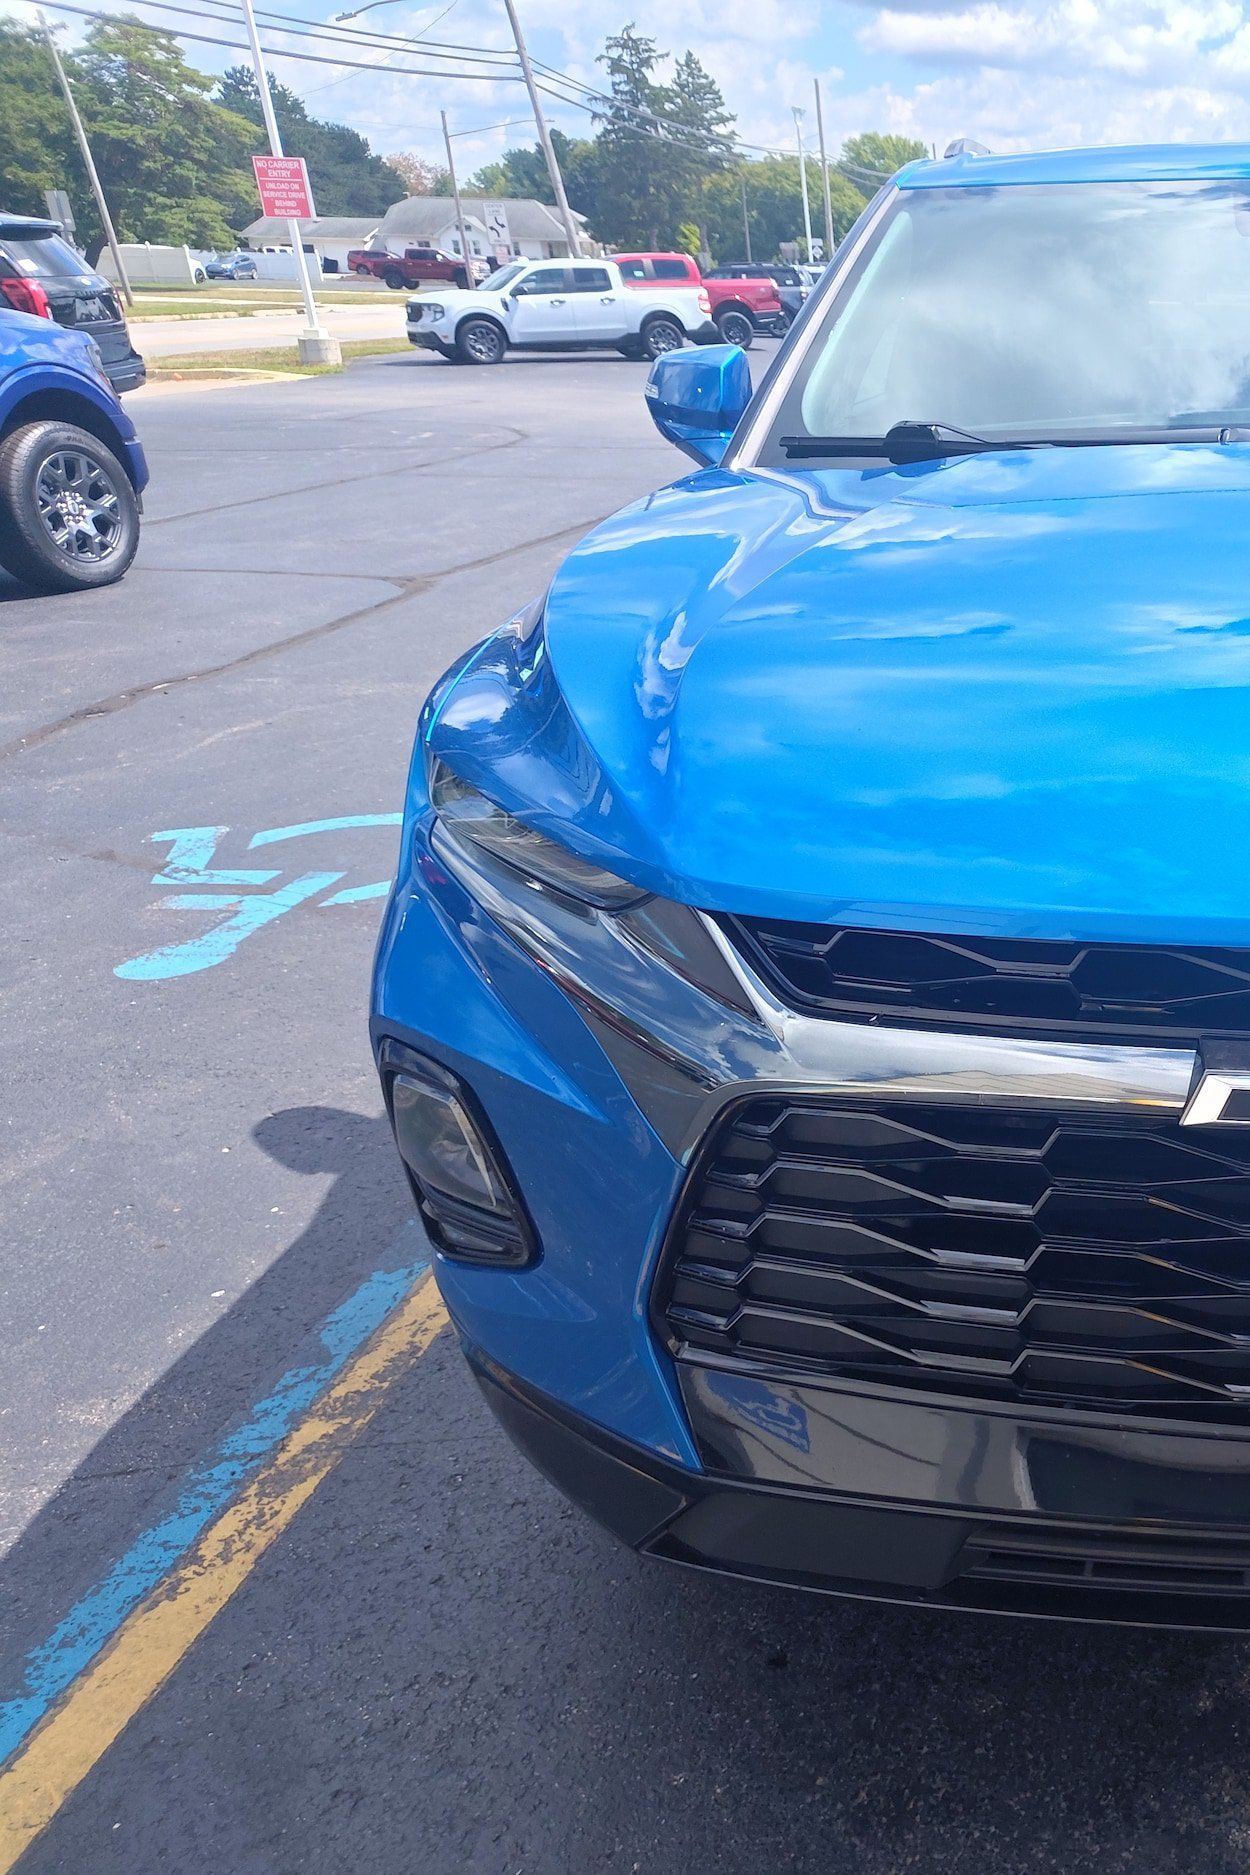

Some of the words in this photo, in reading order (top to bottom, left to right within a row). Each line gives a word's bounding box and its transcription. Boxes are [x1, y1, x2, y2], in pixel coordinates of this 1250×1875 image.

[256, 160, 267, 168] NO
[268, 160, 300, 169] CARRIER
[268, 169, 291, 177] ENTRY
[265, 182, 289, 190] UNLOAD
[288, 191, 305, 199] DRIVE
[273, 208, 301, 216] BUILDING
